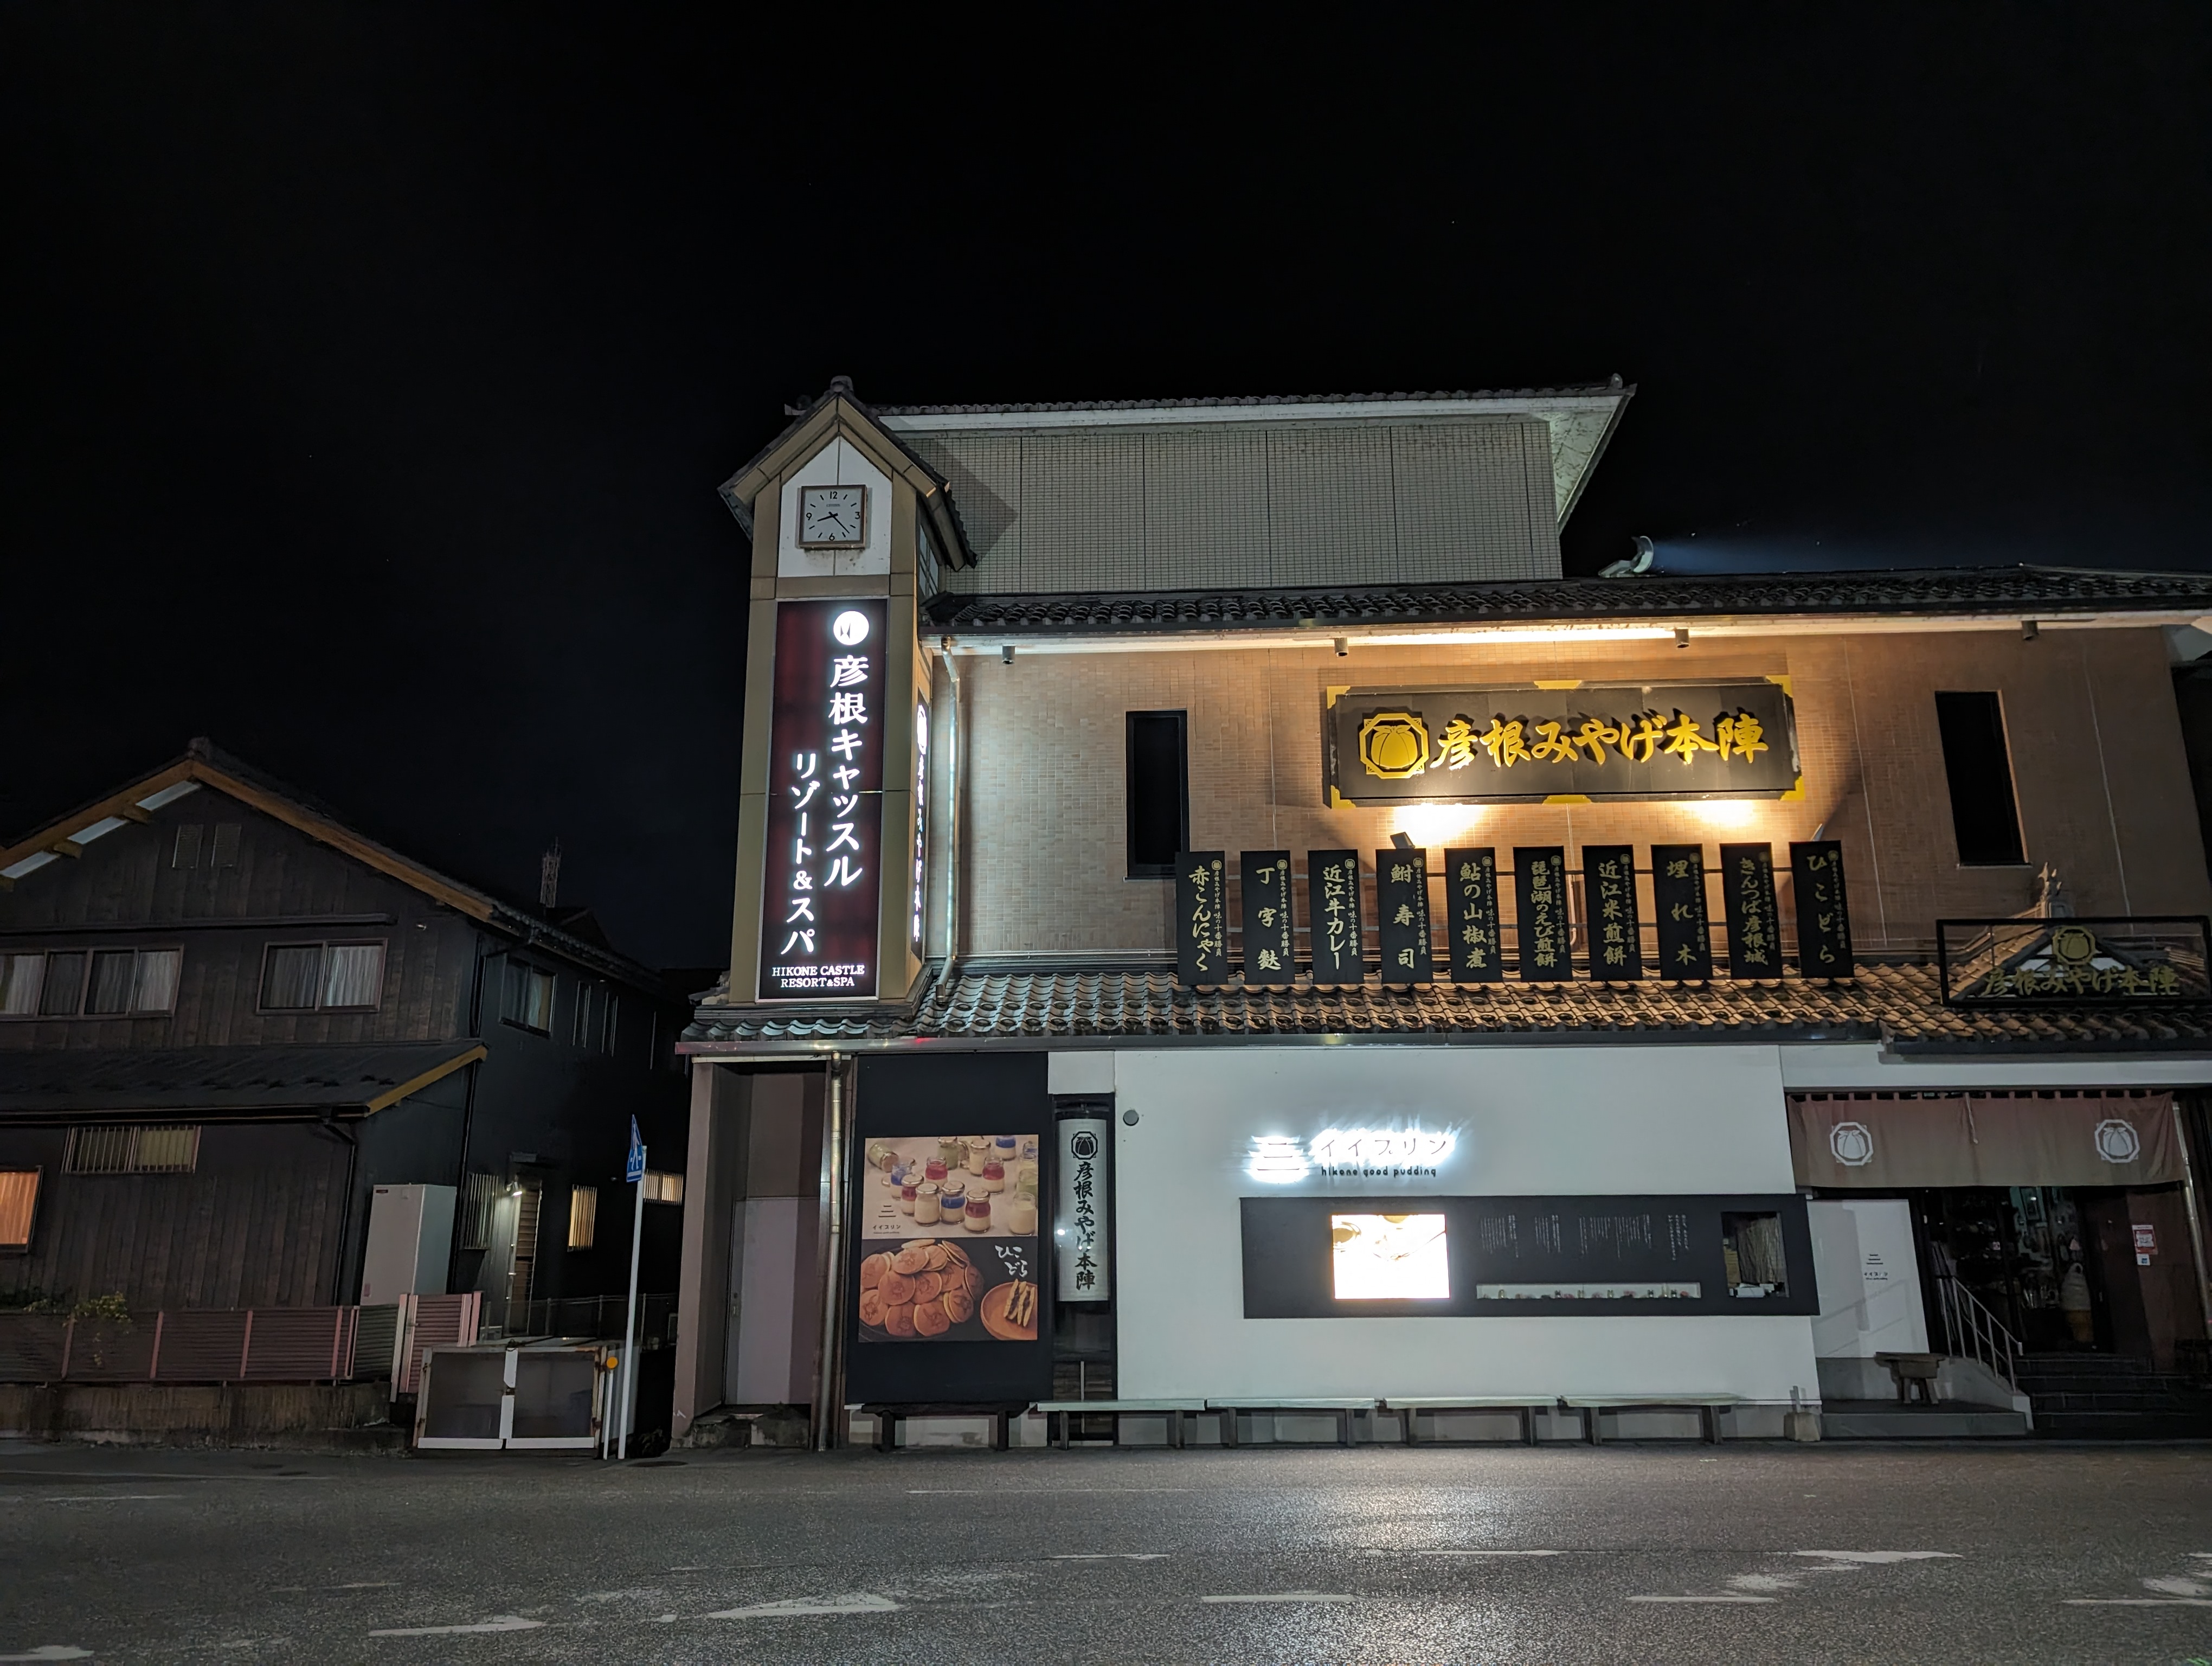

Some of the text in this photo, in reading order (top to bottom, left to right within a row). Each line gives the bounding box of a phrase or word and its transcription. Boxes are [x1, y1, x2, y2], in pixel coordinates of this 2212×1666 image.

[806, 512, 812, 521] 9
[829, 491, 838, 499] 12
[854, 511, 860, 520] 3
[828, 533, 835, 541] 6
[1430, 713, 1769, 770] 彦根みやげ本陣
[824, 655, 869, 888] 彦根キャッスル
[781, 752, 820, 955] リゾート&スパ
[1256, 867, 1282, 971] 丁字麩
[1323, 864, 1347, 970] 近江牛カレー
[1391, 863, 1415, 969] 鮒寿司
[1460, 862, 1488, 969] 鮎の山椒煮
[1531, 860, 1558, 968] 琵琶湖のえび煎餅
[1598, 860, 1628, 966] 近江米煎餅
[1667, 860, 1697, 966] 埋れ木
[1807, 855, 1836, 964] ひこどら
[771, 964, 865, 976] HIKONE CASTLE
[780, 977, 855, 988] RESORT&SPA
[1981, 964, 2179, 997] 彦根みやげ本陣
[1321, 1138, 1446, 1157] イイプリン
[1363, 1166, 1388, 1177] good
[1393, 1166, 1437, 1178] pudding
[994, 1245, 1023, 1258] ひこ
[1073, 1161, 1098, 1291] 彦根みやげ本陣
[1004, 1259, 1028, 1278] どら
